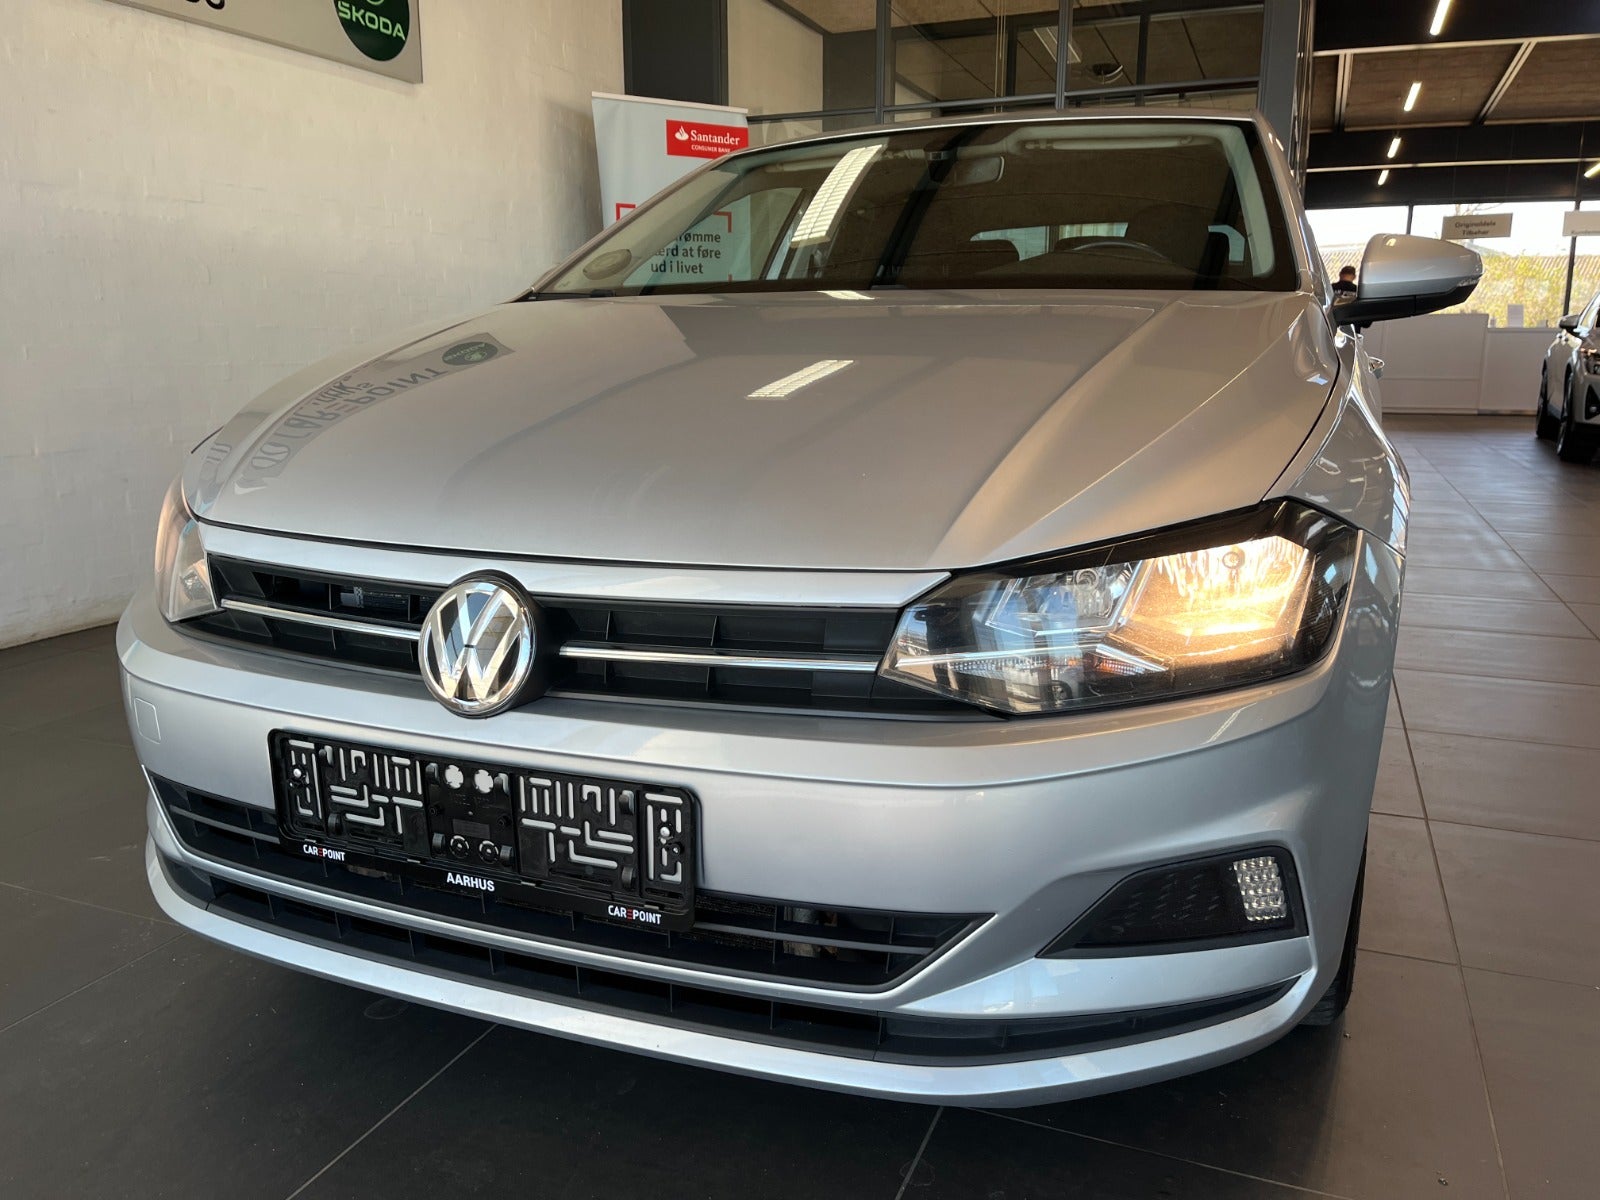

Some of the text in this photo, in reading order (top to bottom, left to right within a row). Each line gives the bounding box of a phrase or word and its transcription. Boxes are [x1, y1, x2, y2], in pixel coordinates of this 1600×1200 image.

[690, 129, 740, 145] Santander
[691, 144, 717, 153] CONSUMER
[682, 246, 694, 258] at
[697, 245, 721, 259] føre
[651, 260, 666, 273] ud
[677, 260, 704, 274] livet
[446, 872, 495, 892] AARHUS
